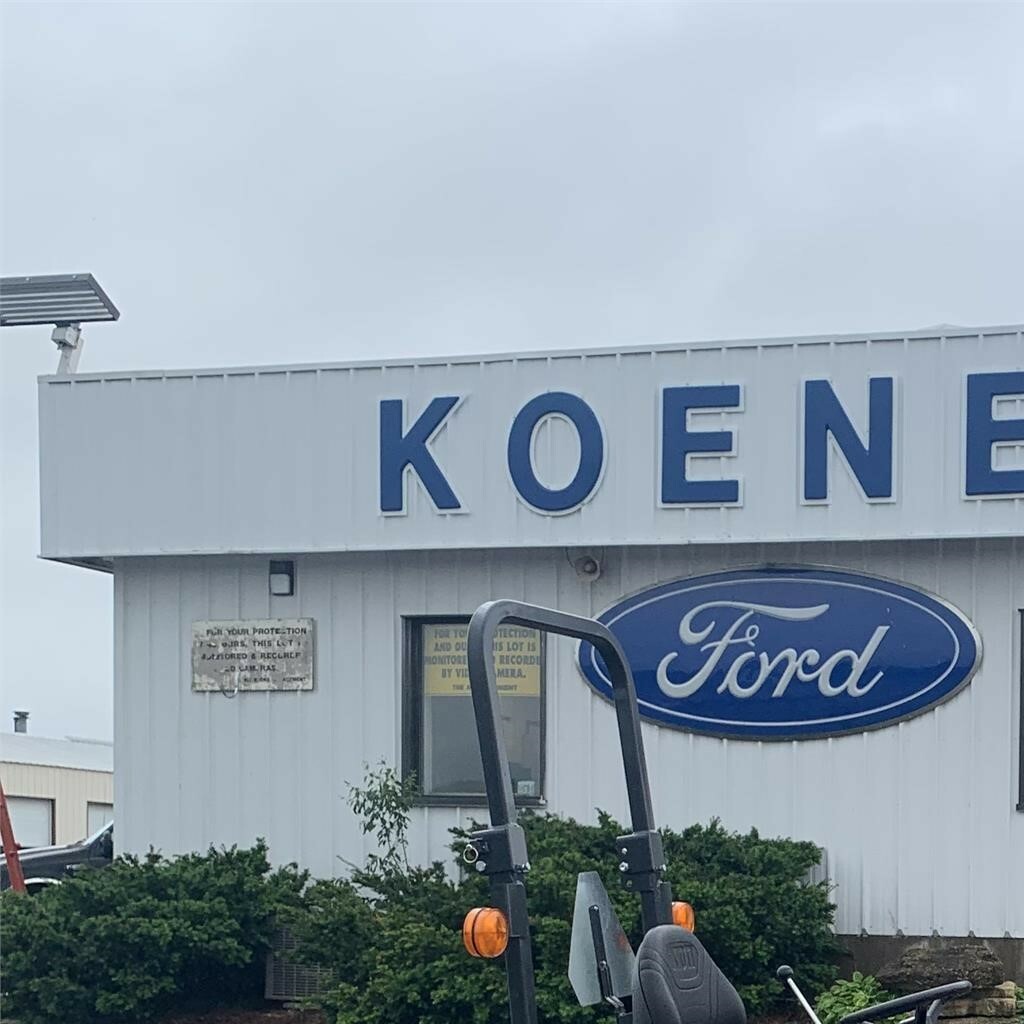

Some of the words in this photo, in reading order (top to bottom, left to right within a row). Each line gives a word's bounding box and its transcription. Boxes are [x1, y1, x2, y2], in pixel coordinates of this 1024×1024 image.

[433, 642, 452, 651] AND
[507, 641, 524, 651] LOT
[527, 641, 537, 651] IS
[656, 600, 891, 698] Ford
[441, 668, 453, 678] BY
